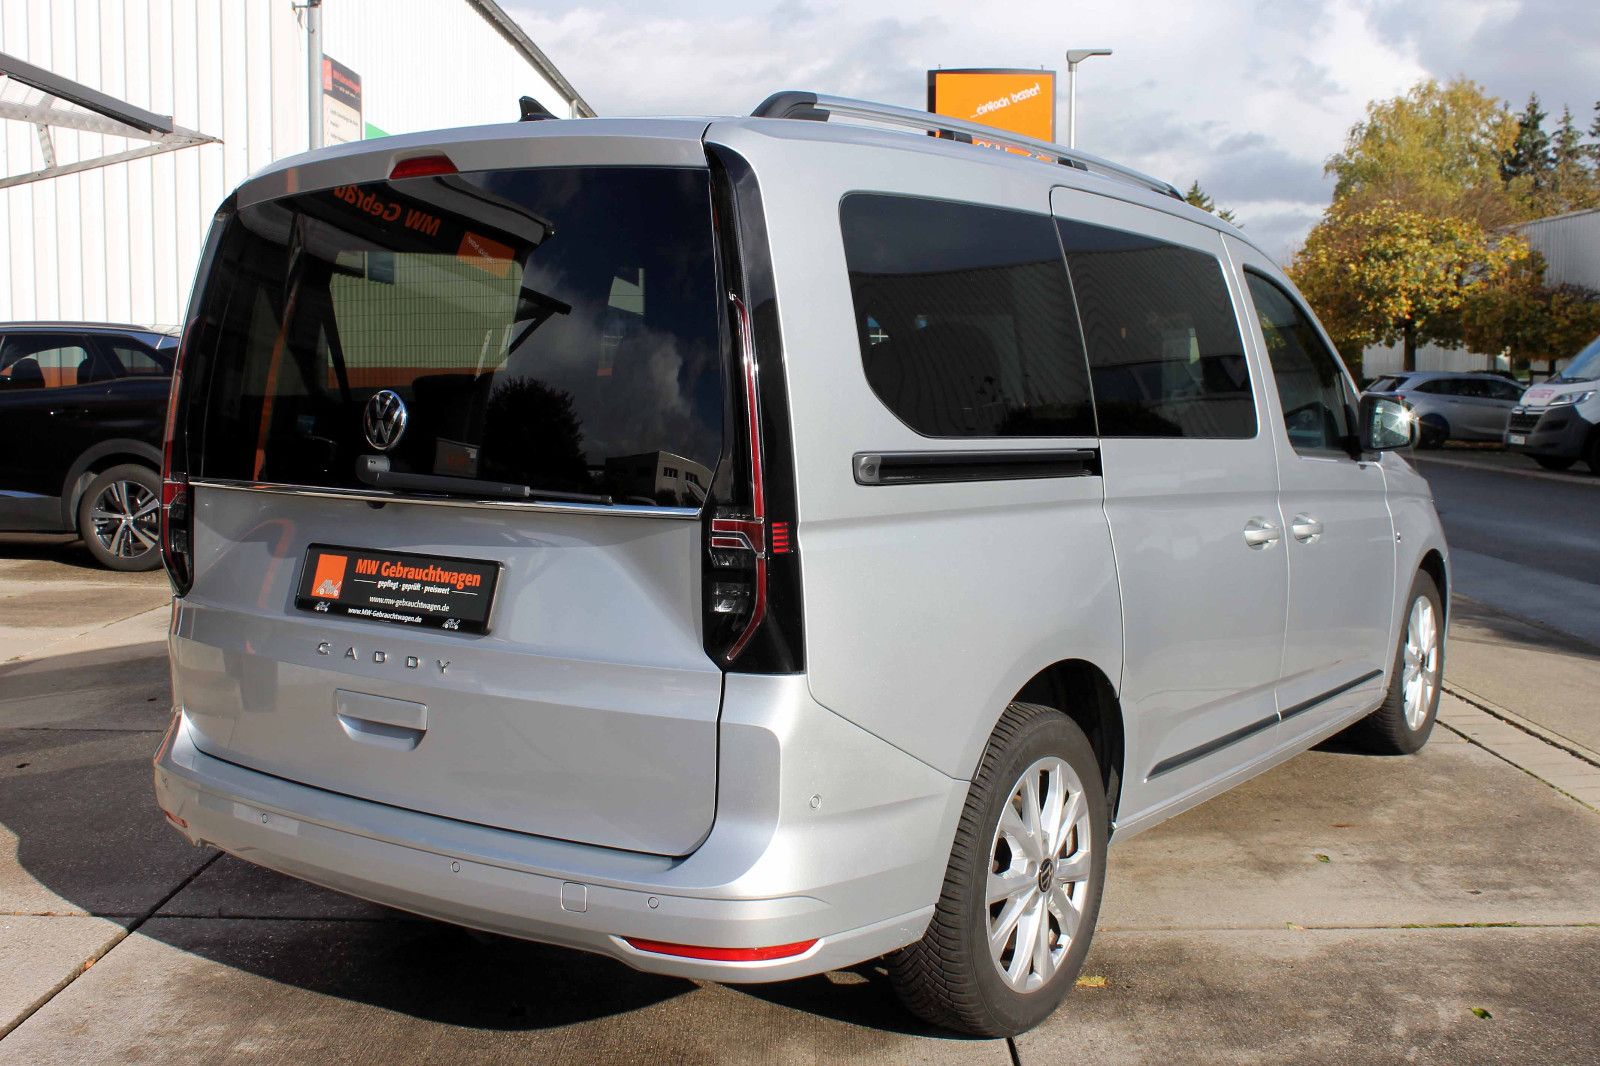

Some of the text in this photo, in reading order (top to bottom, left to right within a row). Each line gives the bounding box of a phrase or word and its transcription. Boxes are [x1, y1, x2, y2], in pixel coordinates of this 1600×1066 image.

[356, 559, 480, 589] MW Gebrauchtwagen
[377, 580, 450, 595] gepflegt geprüft preiswert
[370, 596, 449, 611] www.mw-gebrauchtwagen.de
[348, 608, 422, 622] www.MW-Gebrauchtwagen.de
[318, 642, 450, 674] CADDY
